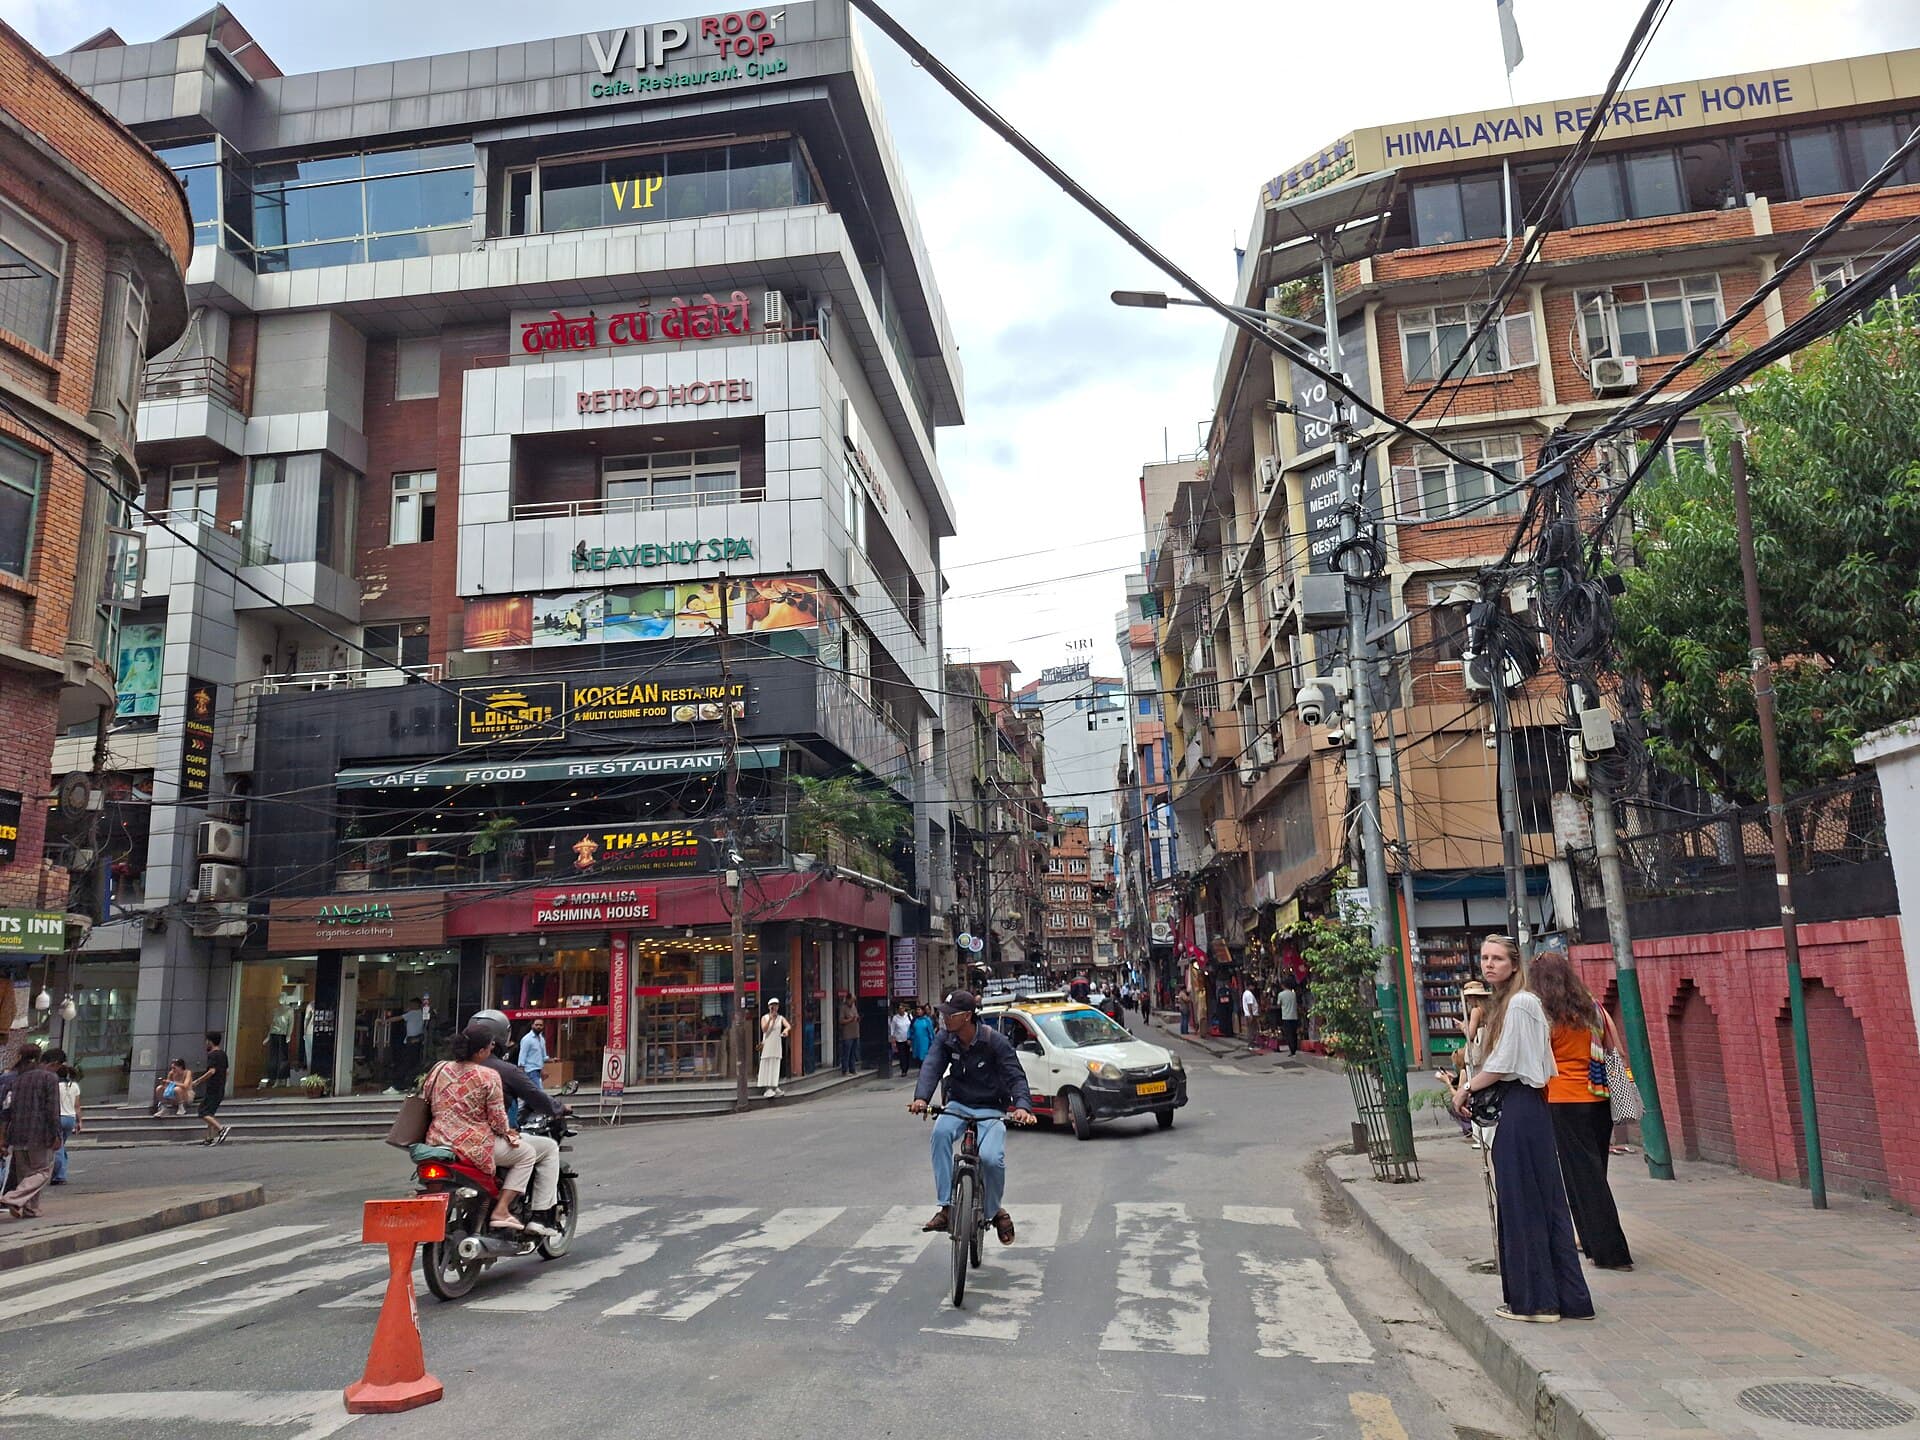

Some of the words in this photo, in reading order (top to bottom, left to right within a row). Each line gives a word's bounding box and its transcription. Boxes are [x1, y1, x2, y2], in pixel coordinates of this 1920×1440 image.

[587, 22, 689, 75] VIP
[714, 33, 775, 60] TOP
[745, 58, 788, 80] Club
[1386, 114, 1544, 158] HIMALAYAN
[1701, 78, 1793, 113] HOME
[1266, 139, 1347, 201] VEGAN
[611, 174, 663, 211] VIP
[576, 385, 659, 415] RETRO
[668, 378, 753, 408] HOTEL
[572, 539, 702, 572] HEAVENLY
[706, 536, 754, 562] SPA
[1065, 637, 1094, 650] SIRI
[573, 683, 659, 708] KOREAN
[583, 709, 607, 721] MULTI
[609, 708, 641, 719] CUISINE
[643, 706, 667, 717] FOOD
[187, 766, 207, 778] FOOD
[369, 773, 428, 786] CAFE
[465, 768, 527, 783] FOOD
[568, 753, 728, 777] RESTAURANT
[188, 779, 204, 791] BAR
[602, 829, 698, 849] THAMEL
[671, 847, 698, 857] BAR
[570, 890, 637, 905] MONALISA
[537, 907, 602, 922] PASHMINA
[606, 905, 649, 918] HOUSE
[28, 918, 62, 935] INN
[862, 979, 885, 988] HOUSE
